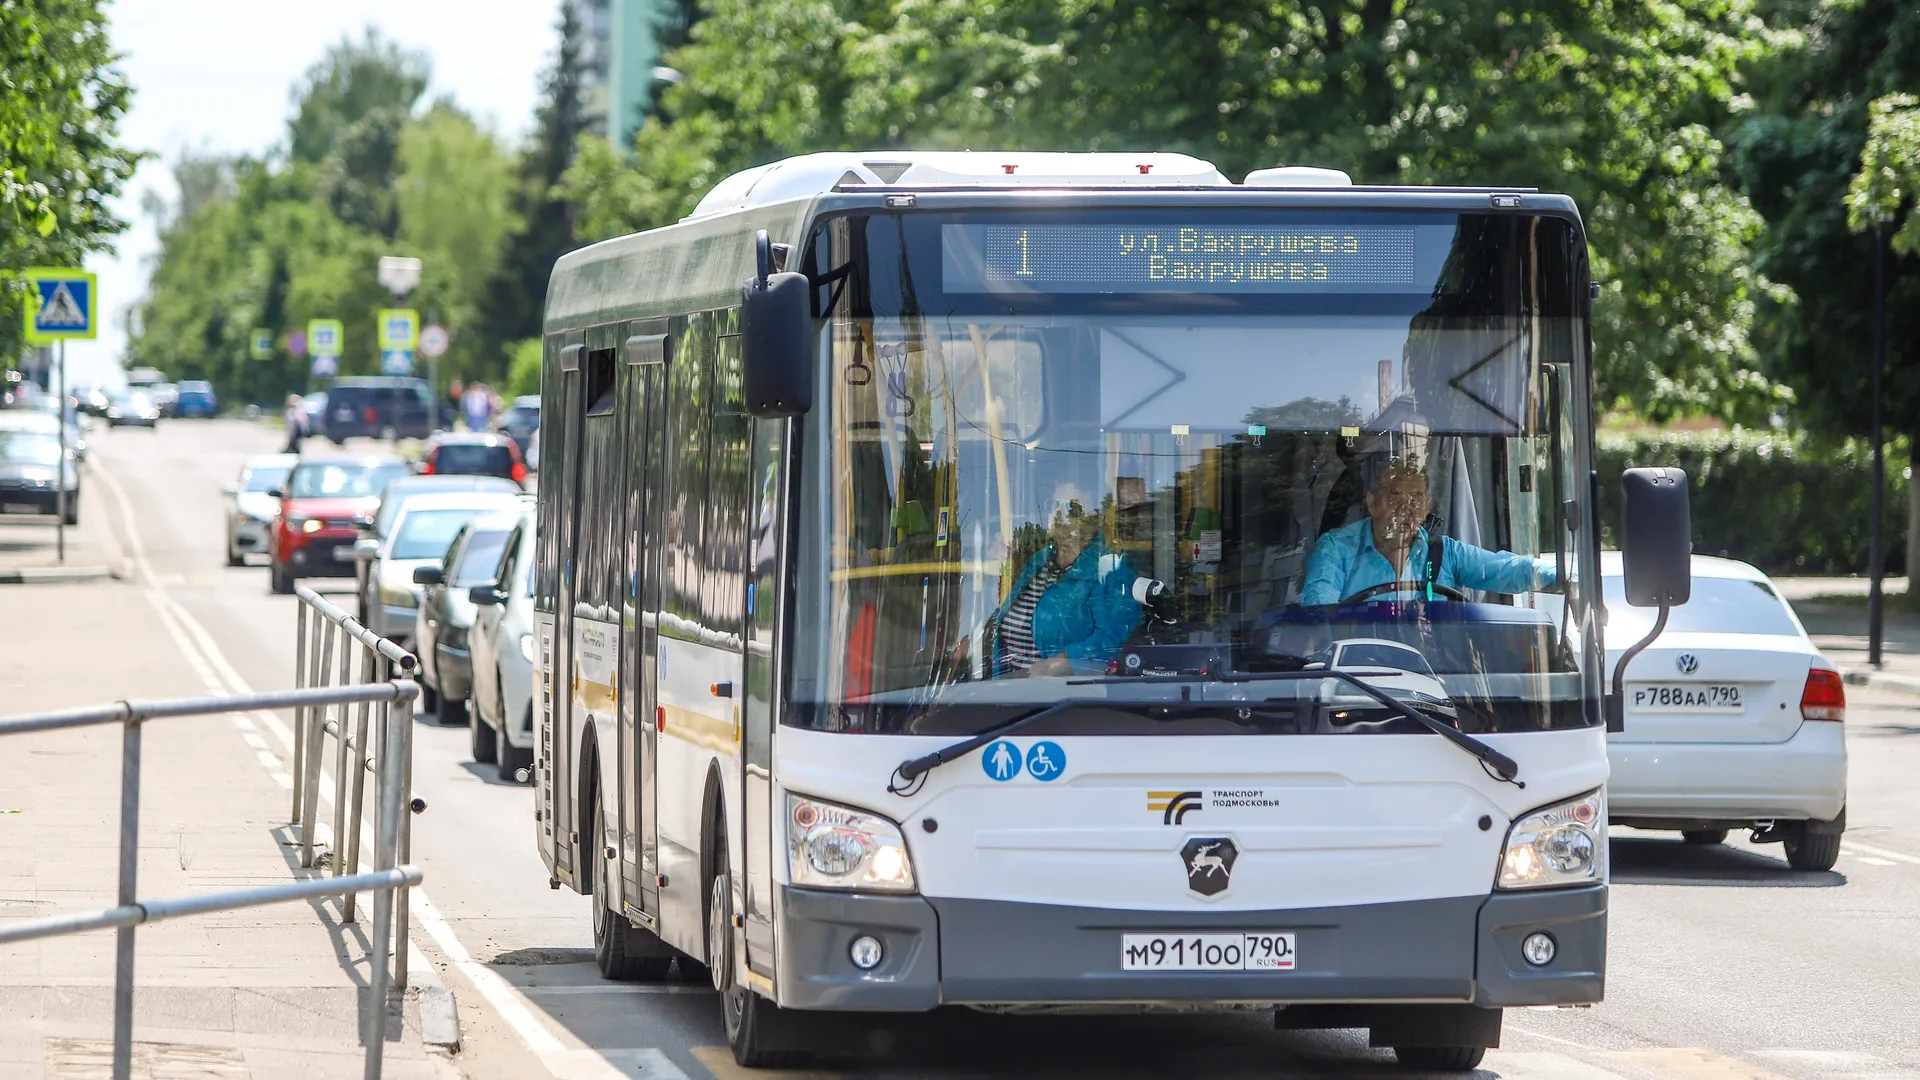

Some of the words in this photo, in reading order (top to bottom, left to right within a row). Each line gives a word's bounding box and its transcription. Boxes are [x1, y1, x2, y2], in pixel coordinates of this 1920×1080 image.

[1119, 228, 1360, 256] ул.Вахрушева
[1016, 229, 1033, 276] 1
[1149, 255, 1329, 283] Вахрушева
[1711, 686, 1739, 701] 790
[1213, 790, 1264, 798] ТРАНСПОРТ
[1213, 800, 1280, 808] ПОДМОСКОВЬЯ
[1247, 936, 1287, 957] 790
[1256, 958, 1277, 967] RUS
